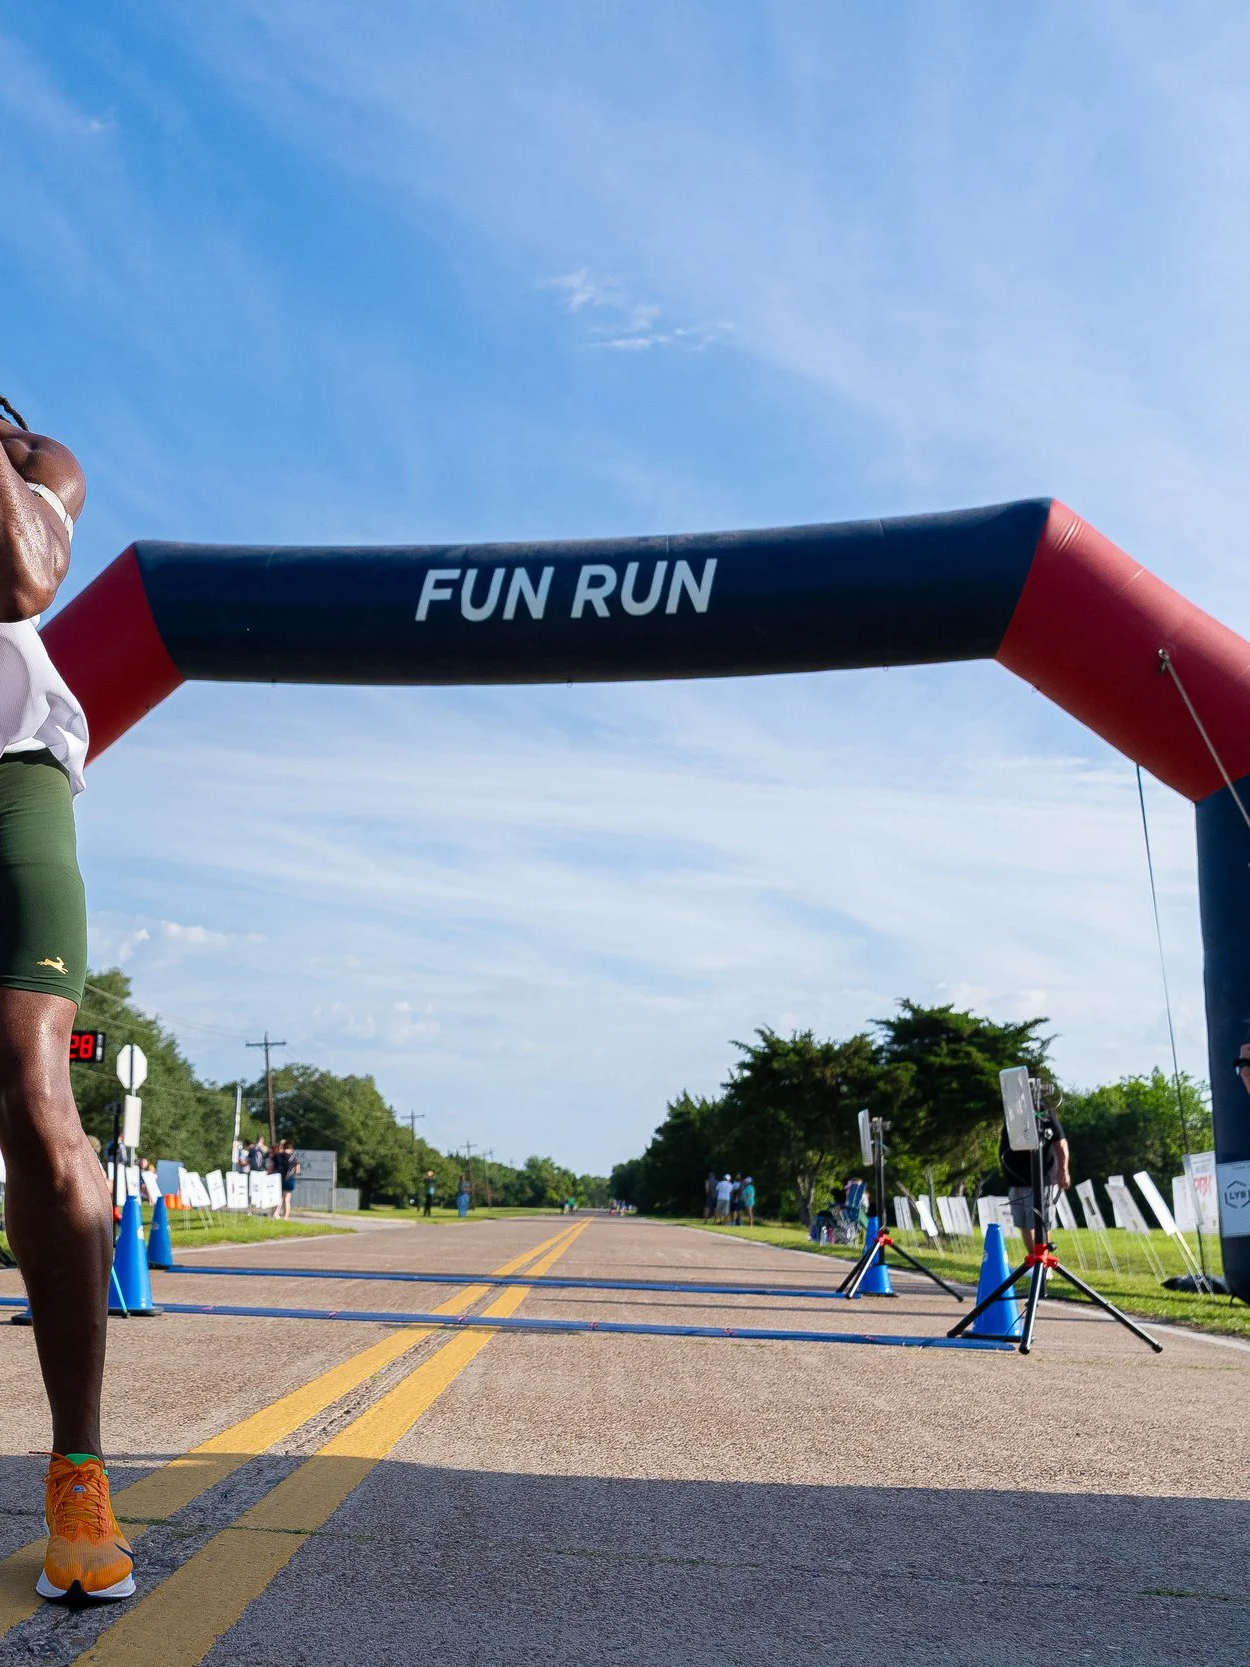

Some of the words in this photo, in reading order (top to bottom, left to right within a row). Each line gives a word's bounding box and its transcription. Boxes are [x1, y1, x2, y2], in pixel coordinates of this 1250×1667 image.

[414, 566, 555, 622] FUN
[570, 558, 718, 618] RUN
[69, 1034, 94, 1059] 28
